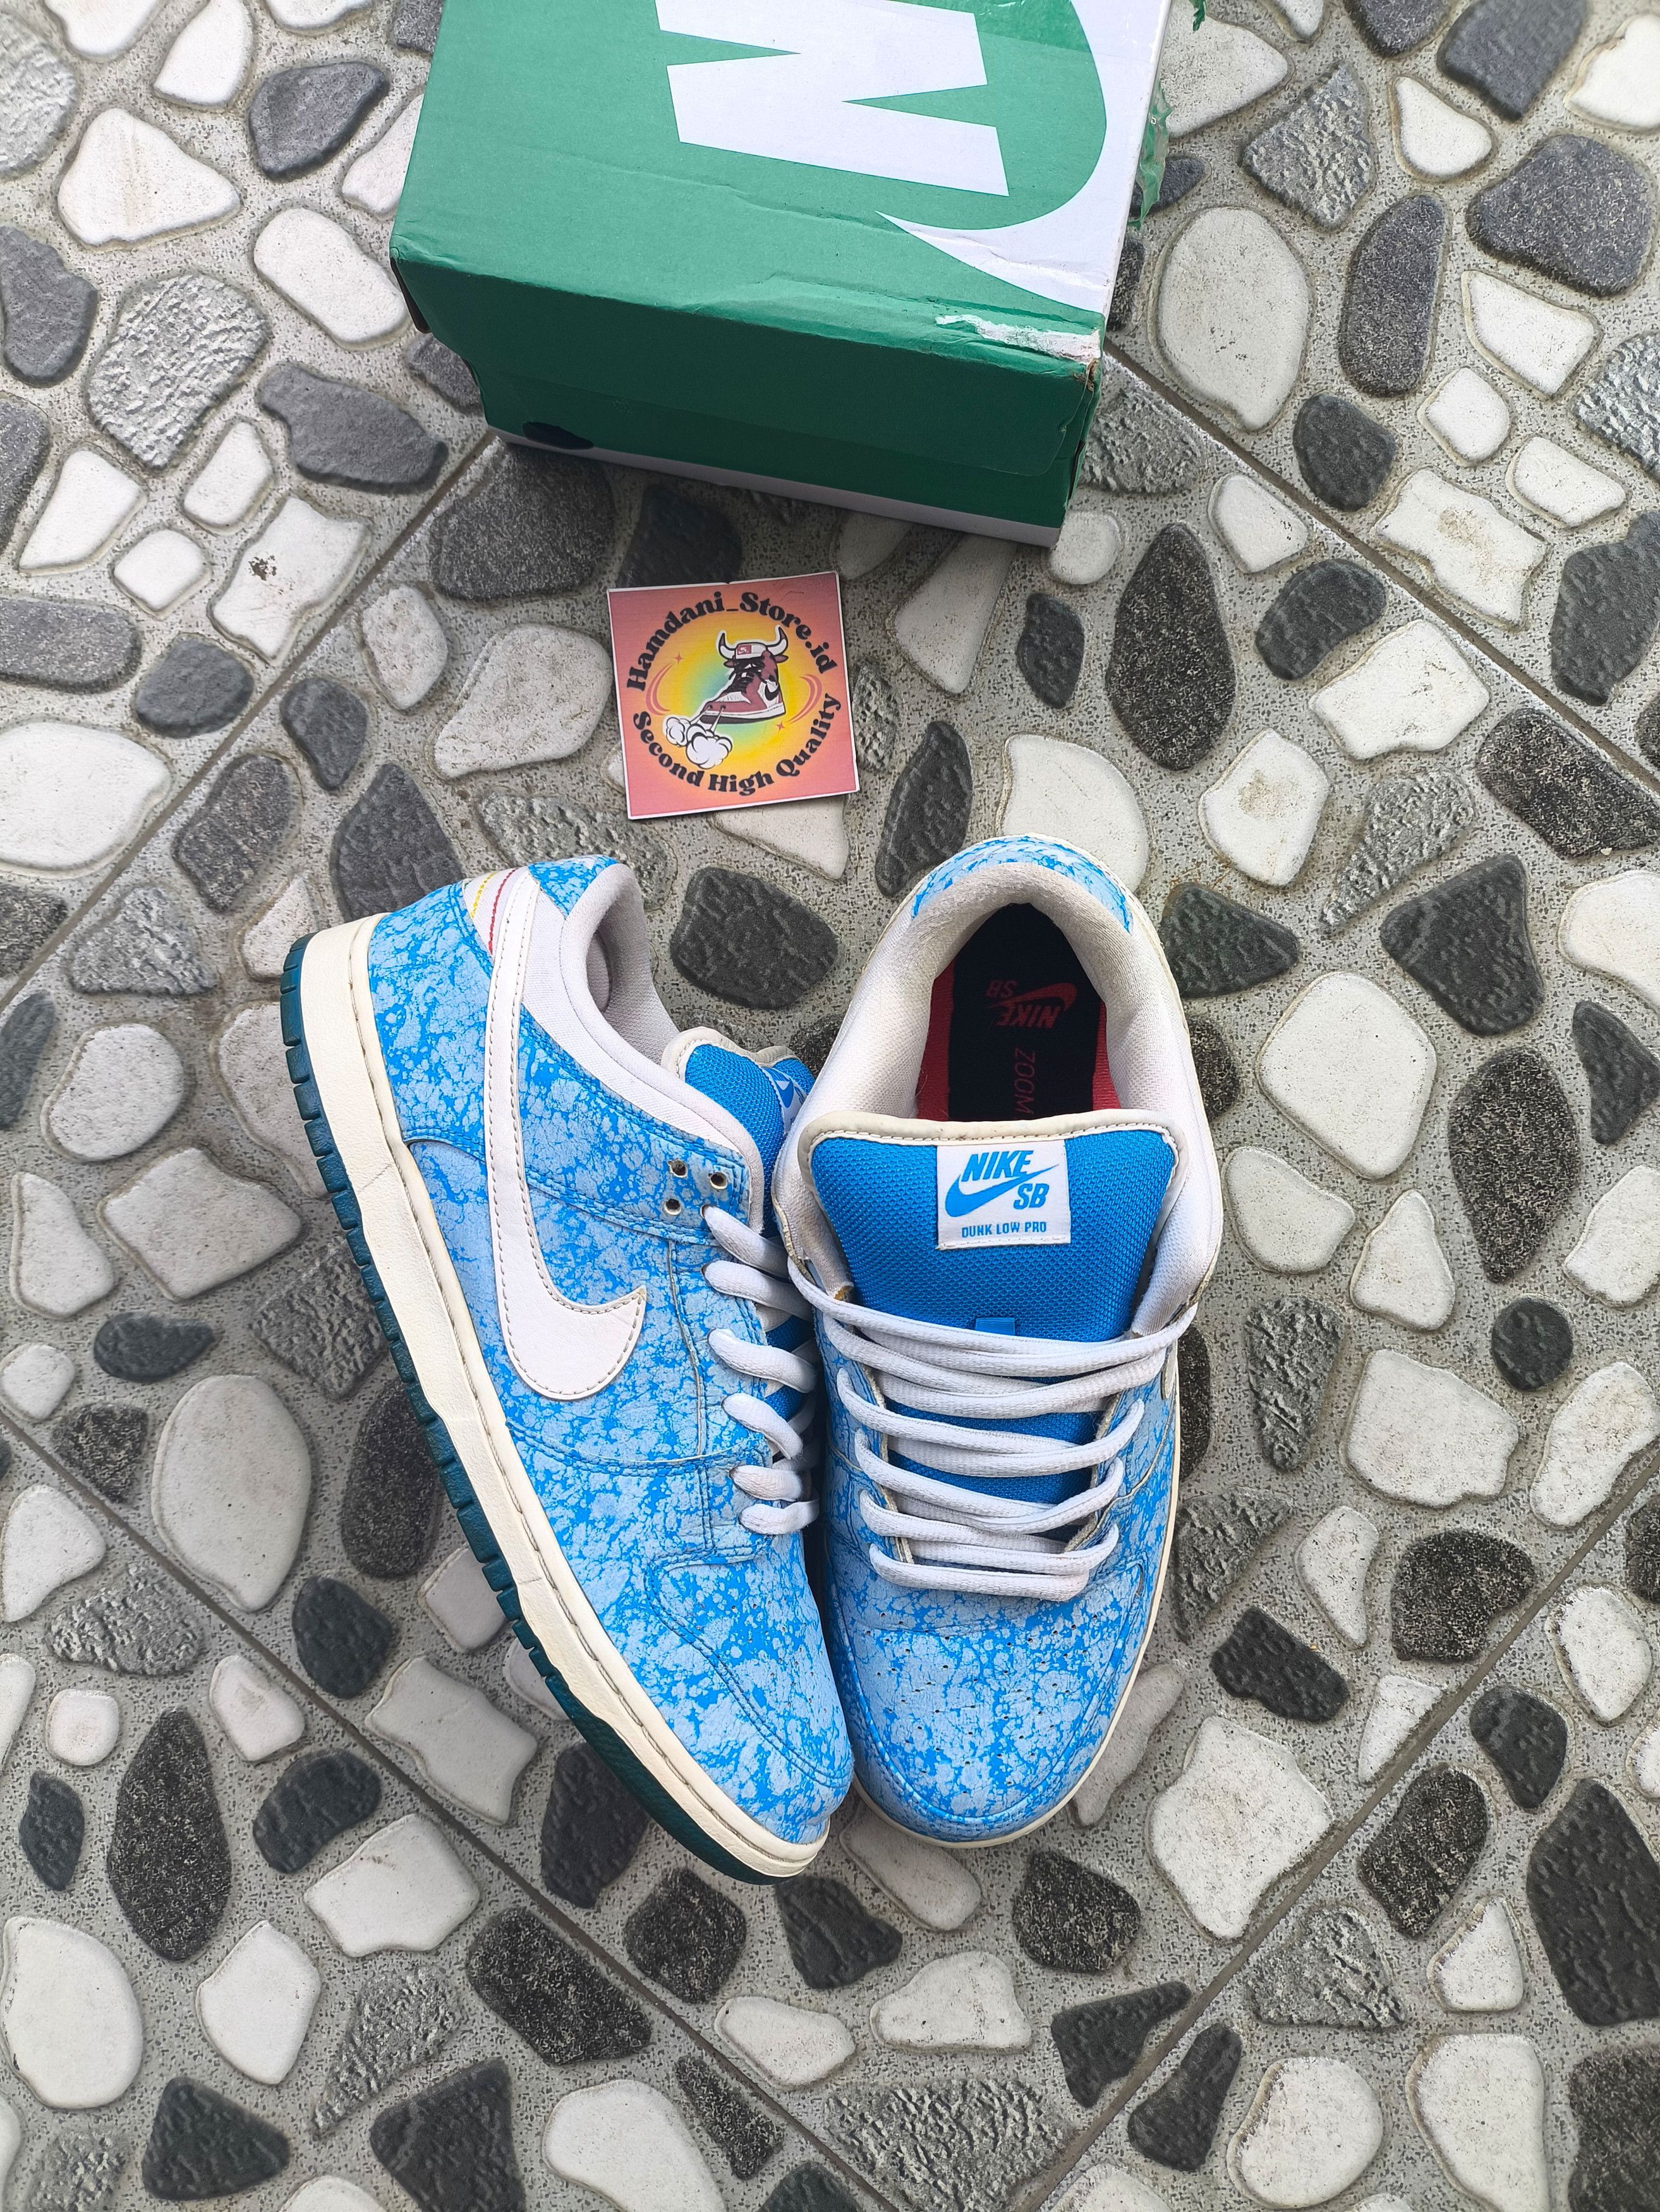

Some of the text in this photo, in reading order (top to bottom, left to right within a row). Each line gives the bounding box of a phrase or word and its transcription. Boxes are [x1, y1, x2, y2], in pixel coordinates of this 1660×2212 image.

[627, 591, 837, 691] Hamdani_Store.id
[633, 693, 842, 796] Second High Quality
[984, 980, 1017, 998] SB
[997, 1004, 1061, 1029] NIKE
[1014, 1047, 1036, 1115] ZOOM
[960, 1150, 1034, 1182] NIKE
[1013, 1183, 1050, 1210] SB
[961, 1221, 1047, 1238] DUNK LOW PRO
